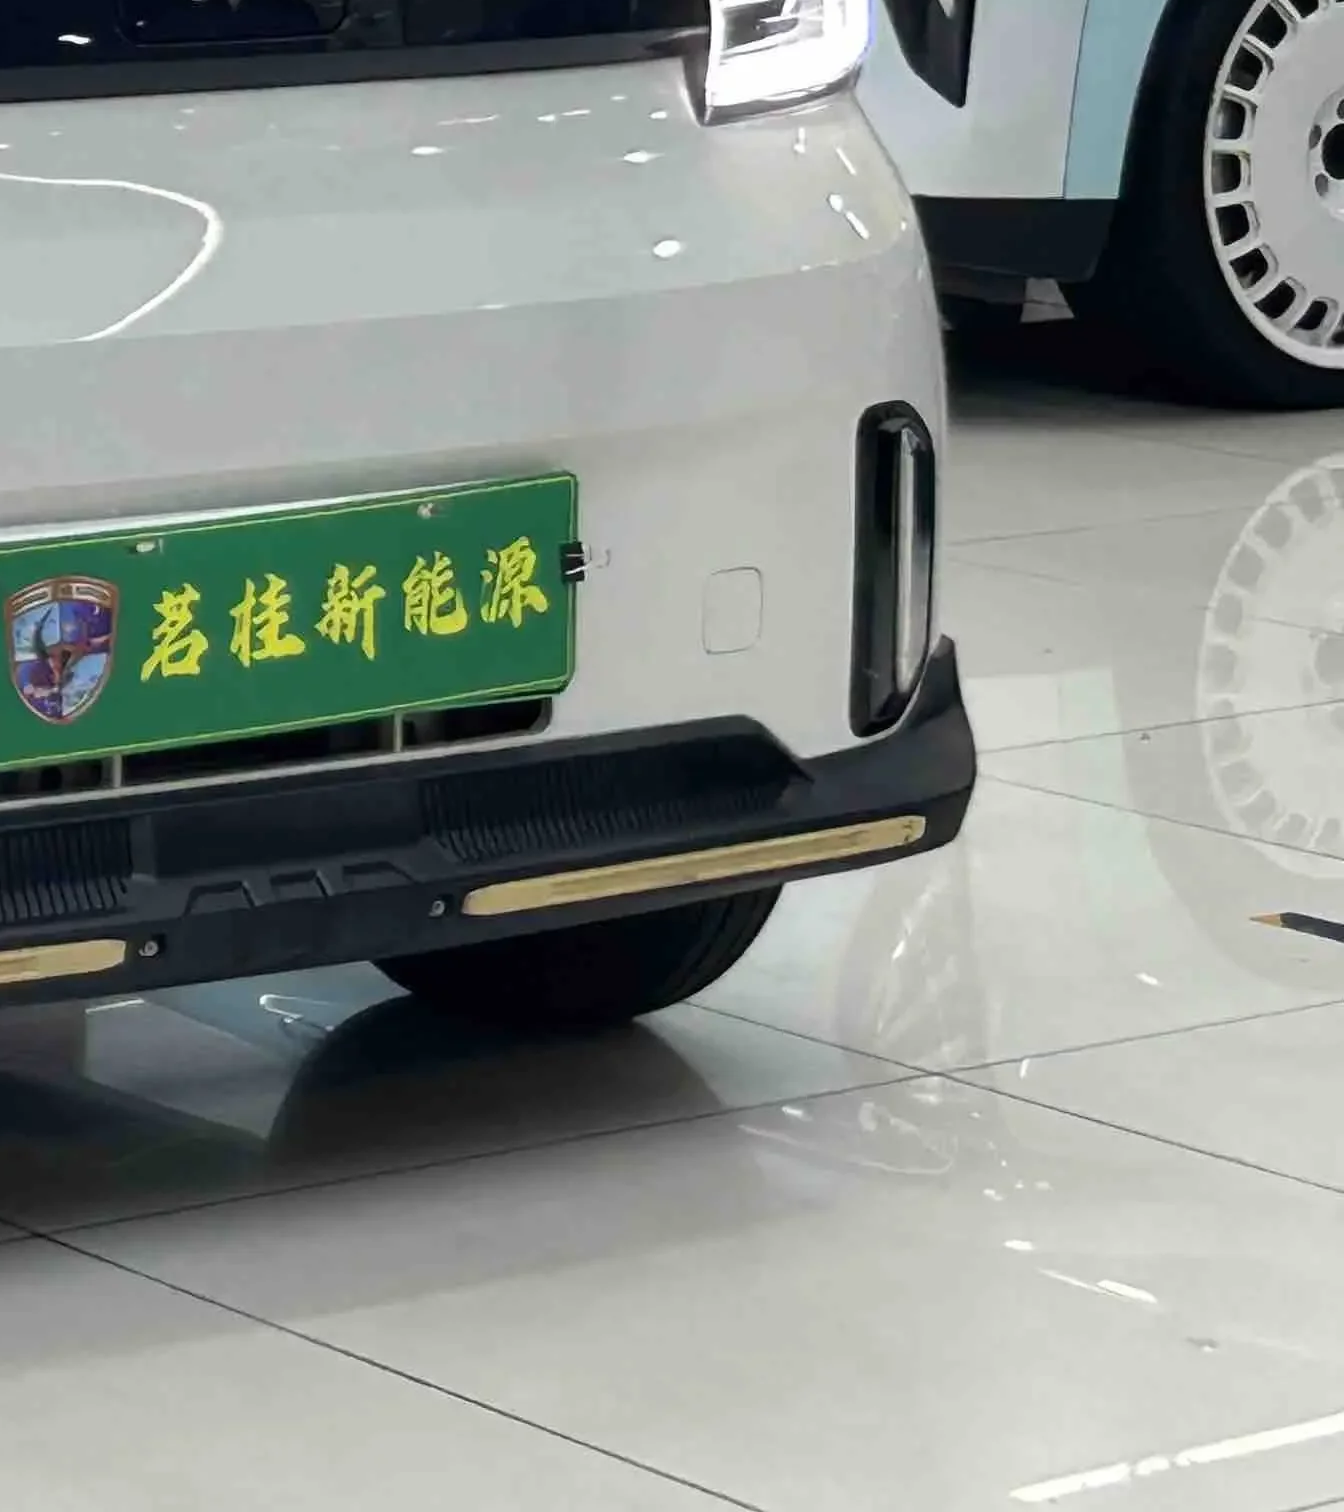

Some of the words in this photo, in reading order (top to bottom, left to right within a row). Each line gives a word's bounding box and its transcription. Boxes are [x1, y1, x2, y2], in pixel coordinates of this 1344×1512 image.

[140, 535, 549, 682] 茗桂新能源
